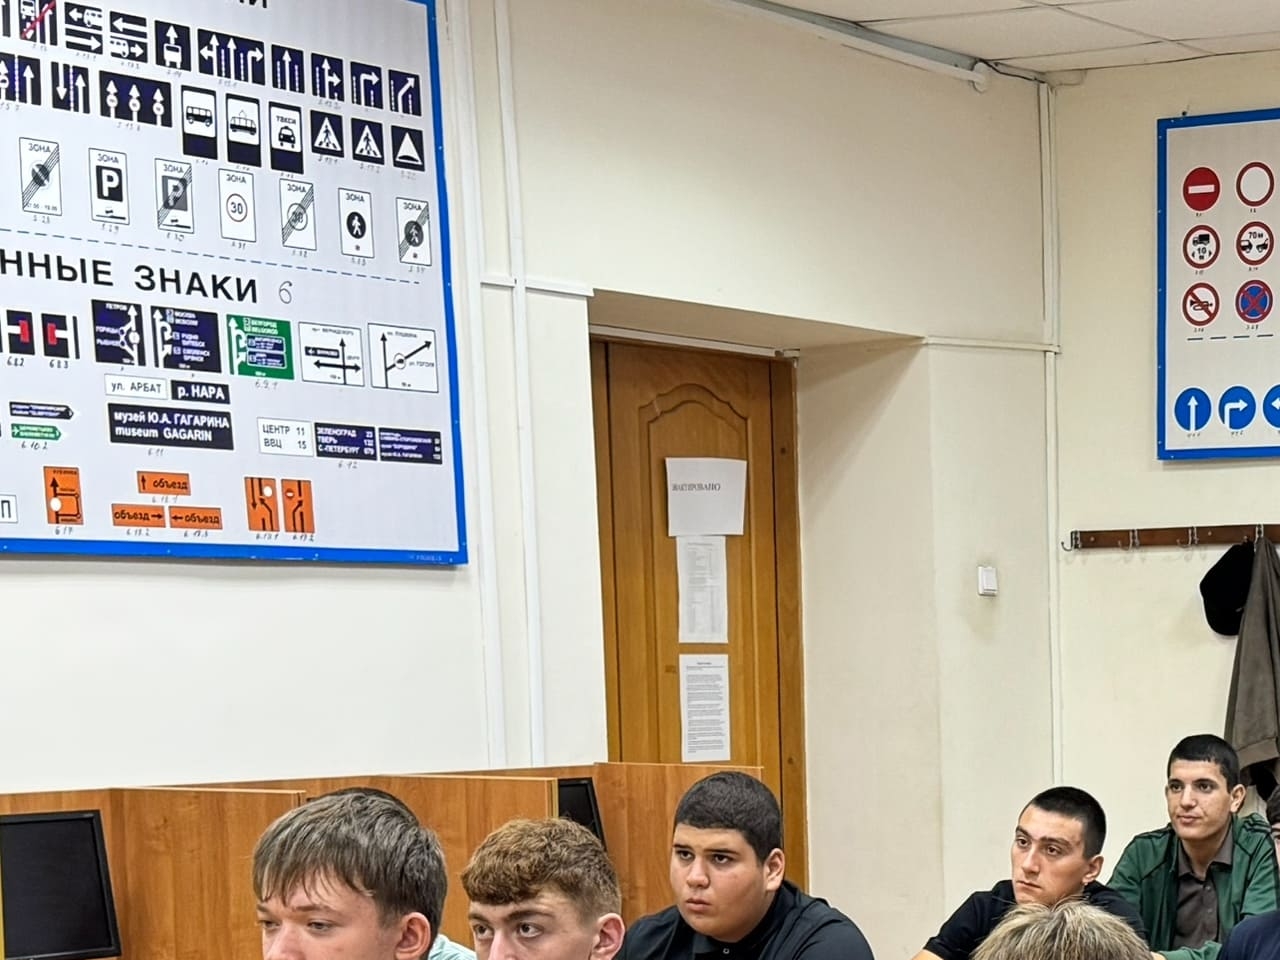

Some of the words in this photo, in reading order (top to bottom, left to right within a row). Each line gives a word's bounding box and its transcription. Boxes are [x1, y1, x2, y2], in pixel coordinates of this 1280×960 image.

[230, 203, 244, 215] 30
[0, 249, 113, 286] ННЫЕ
[134, 265, 257, 304] ЗНАКИ
[279, 281, 292, 304] 6
[130, 382, 162, 393] АРБАТ
[191, 383, 226, 397] НАРА
[114, 409, 146, 424] музей
[174, 413, 230, 428] ГАГАРИНА
[115, 426, 159, 438] museum
[163, 428, 213, 441] GAGARIN
[262, 424, 291, 436] ЦЕНТР
[264, 438, 283, 449] ВВЦ
[298, 440, 307, 450] 15
[153, 478, 188, 491] объезд
[113, 509, 150, 522] объезд
[184, 512, 219, 525] объезд
